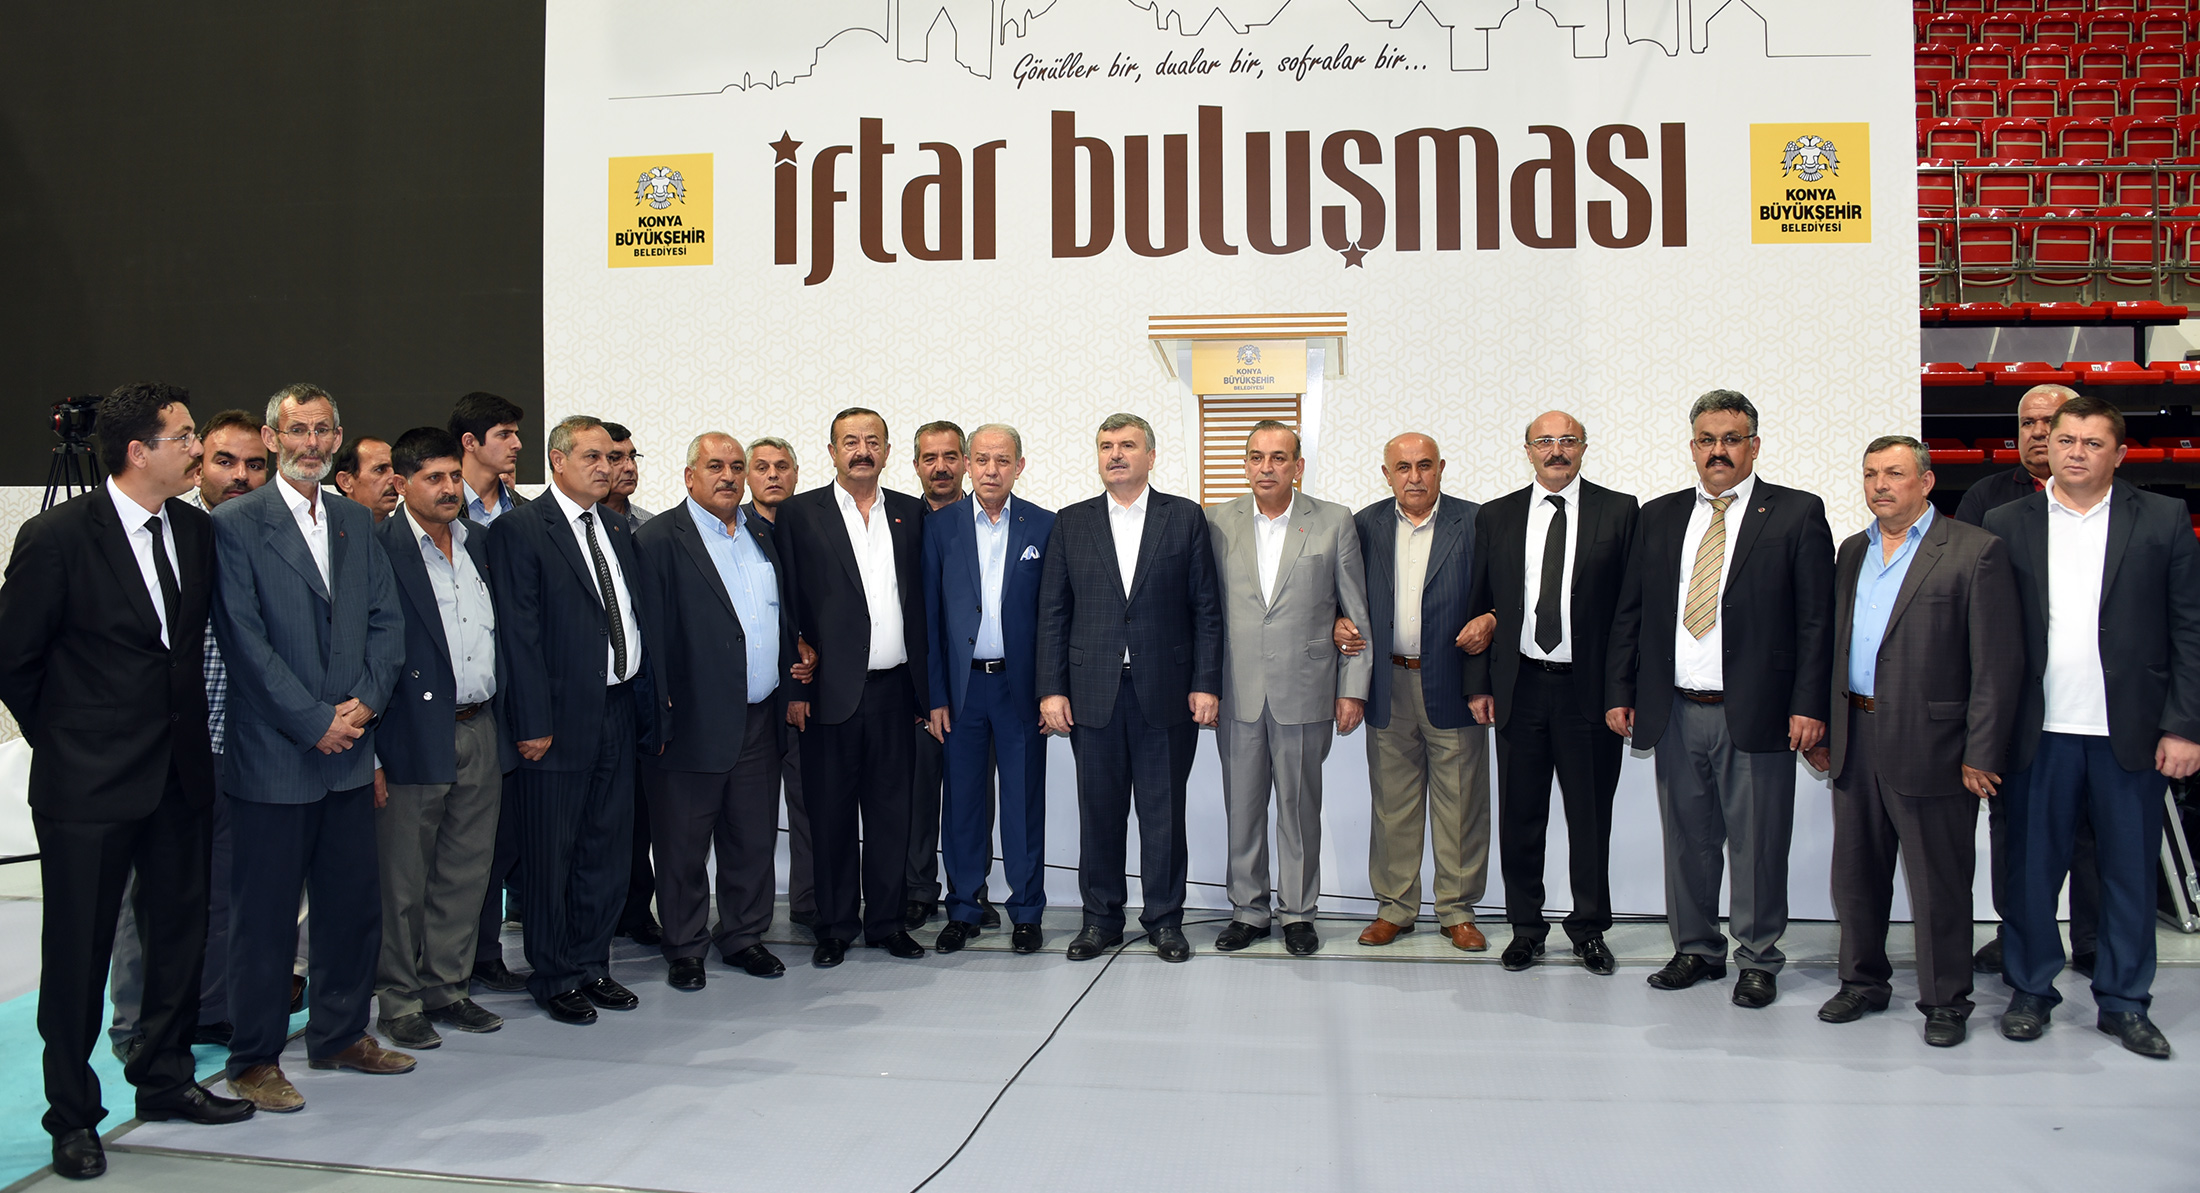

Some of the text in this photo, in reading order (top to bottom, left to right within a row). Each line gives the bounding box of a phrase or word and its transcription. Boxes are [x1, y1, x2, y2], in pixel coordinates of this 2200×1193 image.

[1013, 43, 1428, 90] Gönüller bir, dualar bir, sofralar bir...
[1051, 104, 1689, 270] buluşması
[1785, 188, 1837, 202] KONYA
[1759, 201, 1862, 222] BÜYÜKŞEHİR
[638, 215, 683, 228] KONYA
[1781, 220, 1842, 233] BELEDİYESİ
[615, 227, 705, 247] BÜYÜKŞEHİR
[633, 245, 687, 257] BELEDİYESİ
[1223, 375, 1275, 385] BÜYÜKŞEHİR
